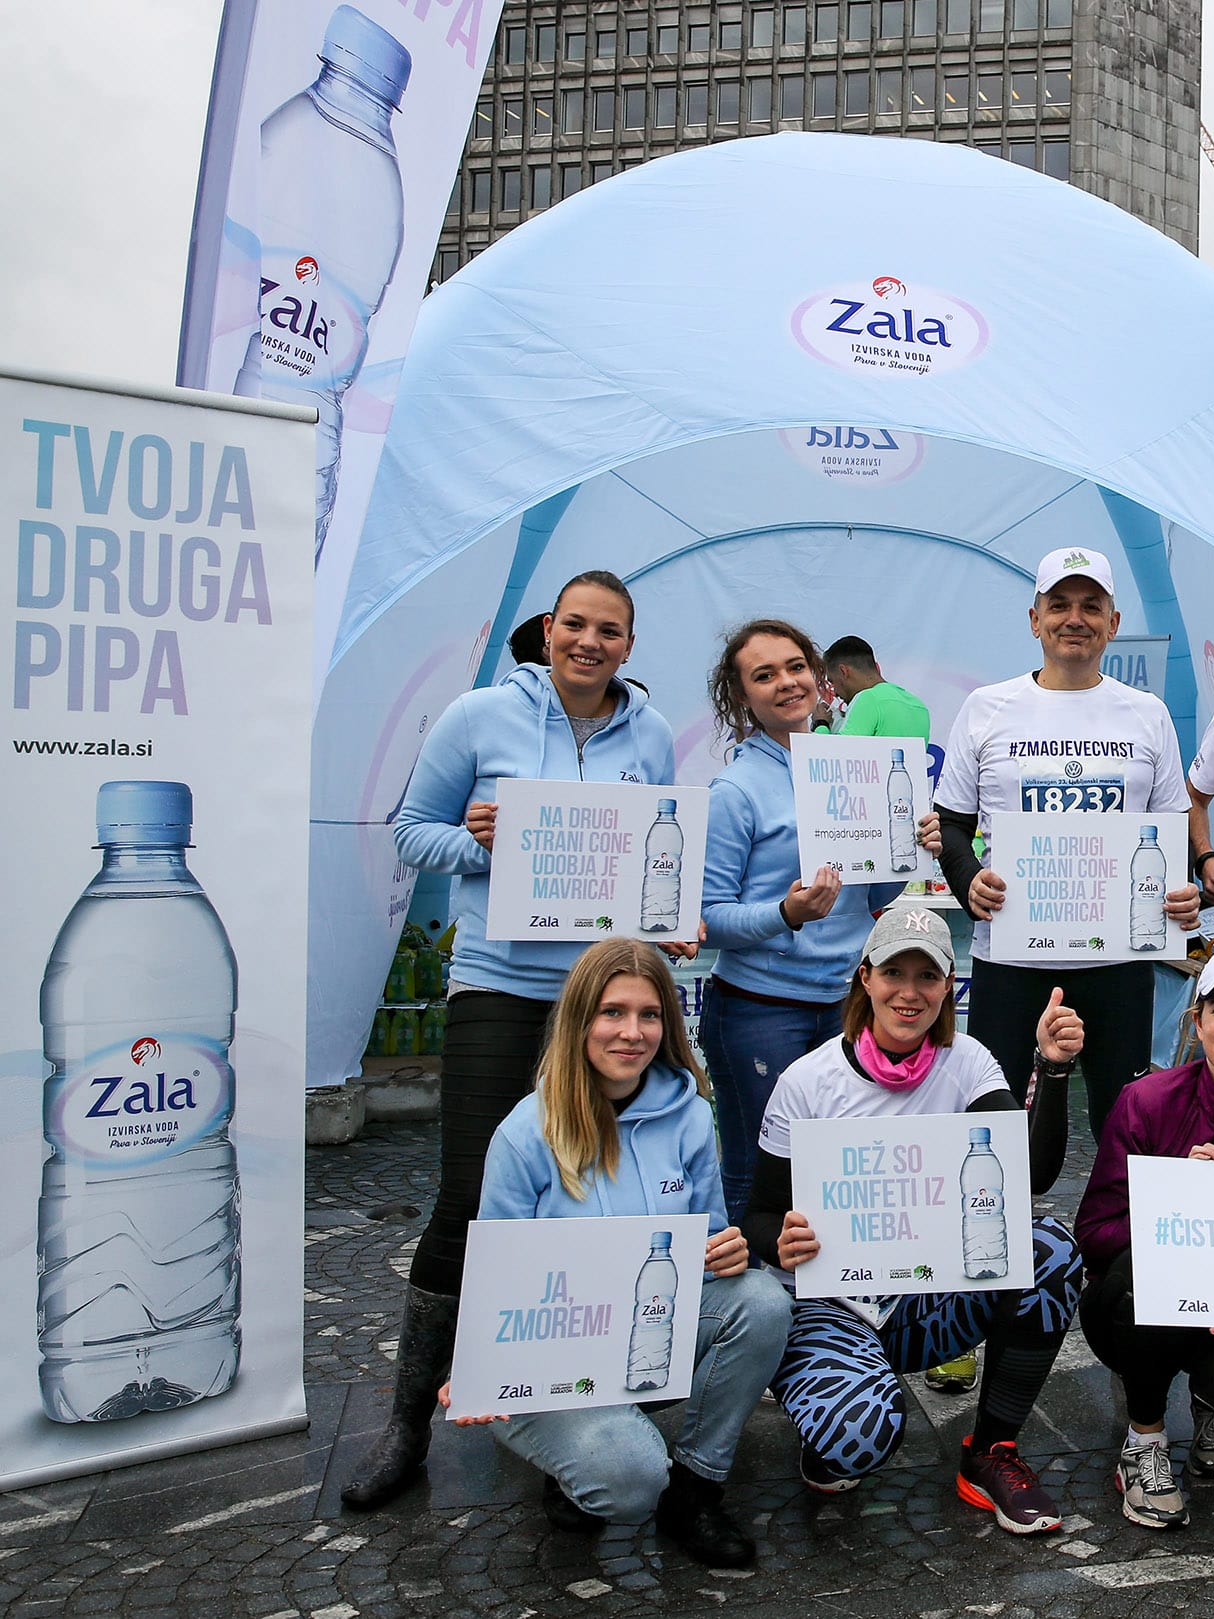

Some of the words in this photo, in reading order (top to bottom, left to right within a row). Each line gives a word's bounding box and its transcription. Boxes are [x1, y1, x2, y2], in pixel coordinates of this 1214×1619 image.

[826, 298, 952, 348] Zala
[261, 334, 290, 354] IRSKA
[851, 343, 901, 359] IZVIRSKA
[904, 352, 932, 363] VODA
[274, 354, 312, 376] Sloveniji
[854, 355, 877, 367] Prva
[888, 359, 930, 375] Sloveniji
[22, 418, 257, 531] TVOJA
[16, 519, 273, 626] DRUGA
[13, 620, 189, 716] PIPA
[13, 738, 153, 757] www.zala.si
[1009, 740, 1135, 759] #ZMAGJEVECVRST
[620, 771, 644, 784] Zal
[808, 758, 843, 784] MOJA
[846, 758, 880, 784] PRVA
[826, 785, 868, 821] 42KA
[1025, 786, 1122, 812] 18232
[539, 805, 563, 828] NA
[568, 806, 619, 830] DRUGI
[893, 804, 909, 815] Zala
[521, 829, 583, 853] STRANI
[589, 831, 633, 854] CONE
[814, 827, 882, 841] #mojadrugapipa
[1031, 836, 1052, 856] NA
[1058, 836, 1103, 856] DRUGI
[532, 854, 598, 876] UDOBJA
[601, 855, 619, 877] JE
[652, 859, 674, 870] Zala
[1016, 858, 1073, 878] STRANI
[1077, 858, 1119, 878] CONE
[532, 878, 615, 900] MAVRICA!
[1027, 880, 1087, 900] UDOBJA
[1090, 880, 1107, 900] JE
[1138, 883, 1159, 892] Zala
[529, 916, 559, 928] Zala
[1029, 902, 1104, 922] MAVRICA!
[1027, 937, 1055, 949] Zala
[85, 1072, 196, 1119] Zala
[108, 1122, 153, 1137] IZVIRSKA
[155, 1120, 180, 1133] VODA
[109, 1138, 132, 1149] Prva
[141, 1133, 176, 1149] Sloveniji
[842, 1140, 886, 1176] DEŽ
[893, 1144, 923, 1174] SO
[822, 1178, 917, 1210] KONFETI
[925, 1176, 945, 1206] IZ
[970, 1196, 996, 1208] Zala
[850, 1211, 919, 1243] NEBA.
[840, 1268, 873, 1282] Zala
[540, 1271, 574, 1306] JA,
[641, 1304, 667, 1316] Zala
[1178, 1299, 1209, 1313] Zala
[495, 1304, 612, 1343] ZMOREM!
[498, 1383, 533, 1400] Zala
